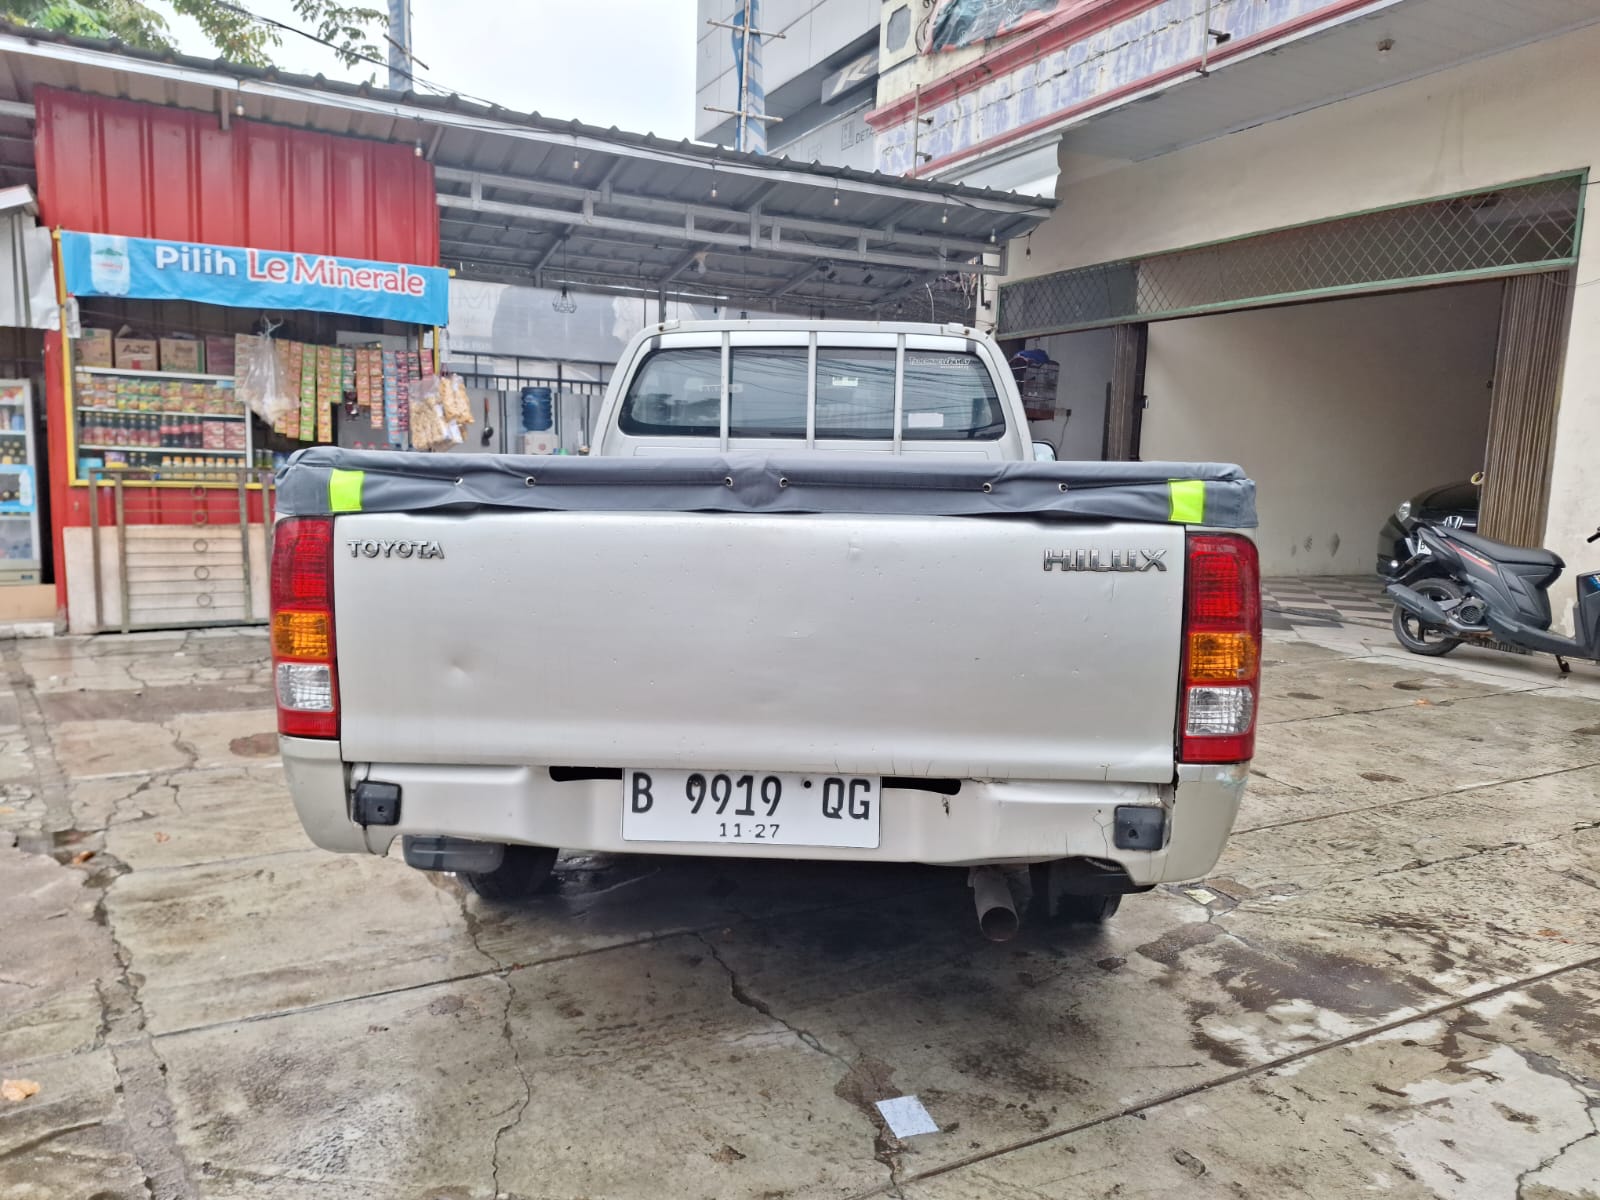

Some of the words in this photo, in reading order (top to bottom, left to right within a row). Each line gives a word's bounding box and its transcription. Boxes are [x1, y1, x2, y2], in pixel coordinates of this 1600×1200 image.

[155, 246, 236, 276] Pilih
[247, 248, 287, 281] Le
[294, 254, 425, 295] Minerale
[347, 539, 445, 559] TOYOTA
[1043, 549, 1168, 572] HILUX
[631, 772, 654, 814] B
[685, 773, 782, 817] 9919
[822, 777, 871, 820] QG
